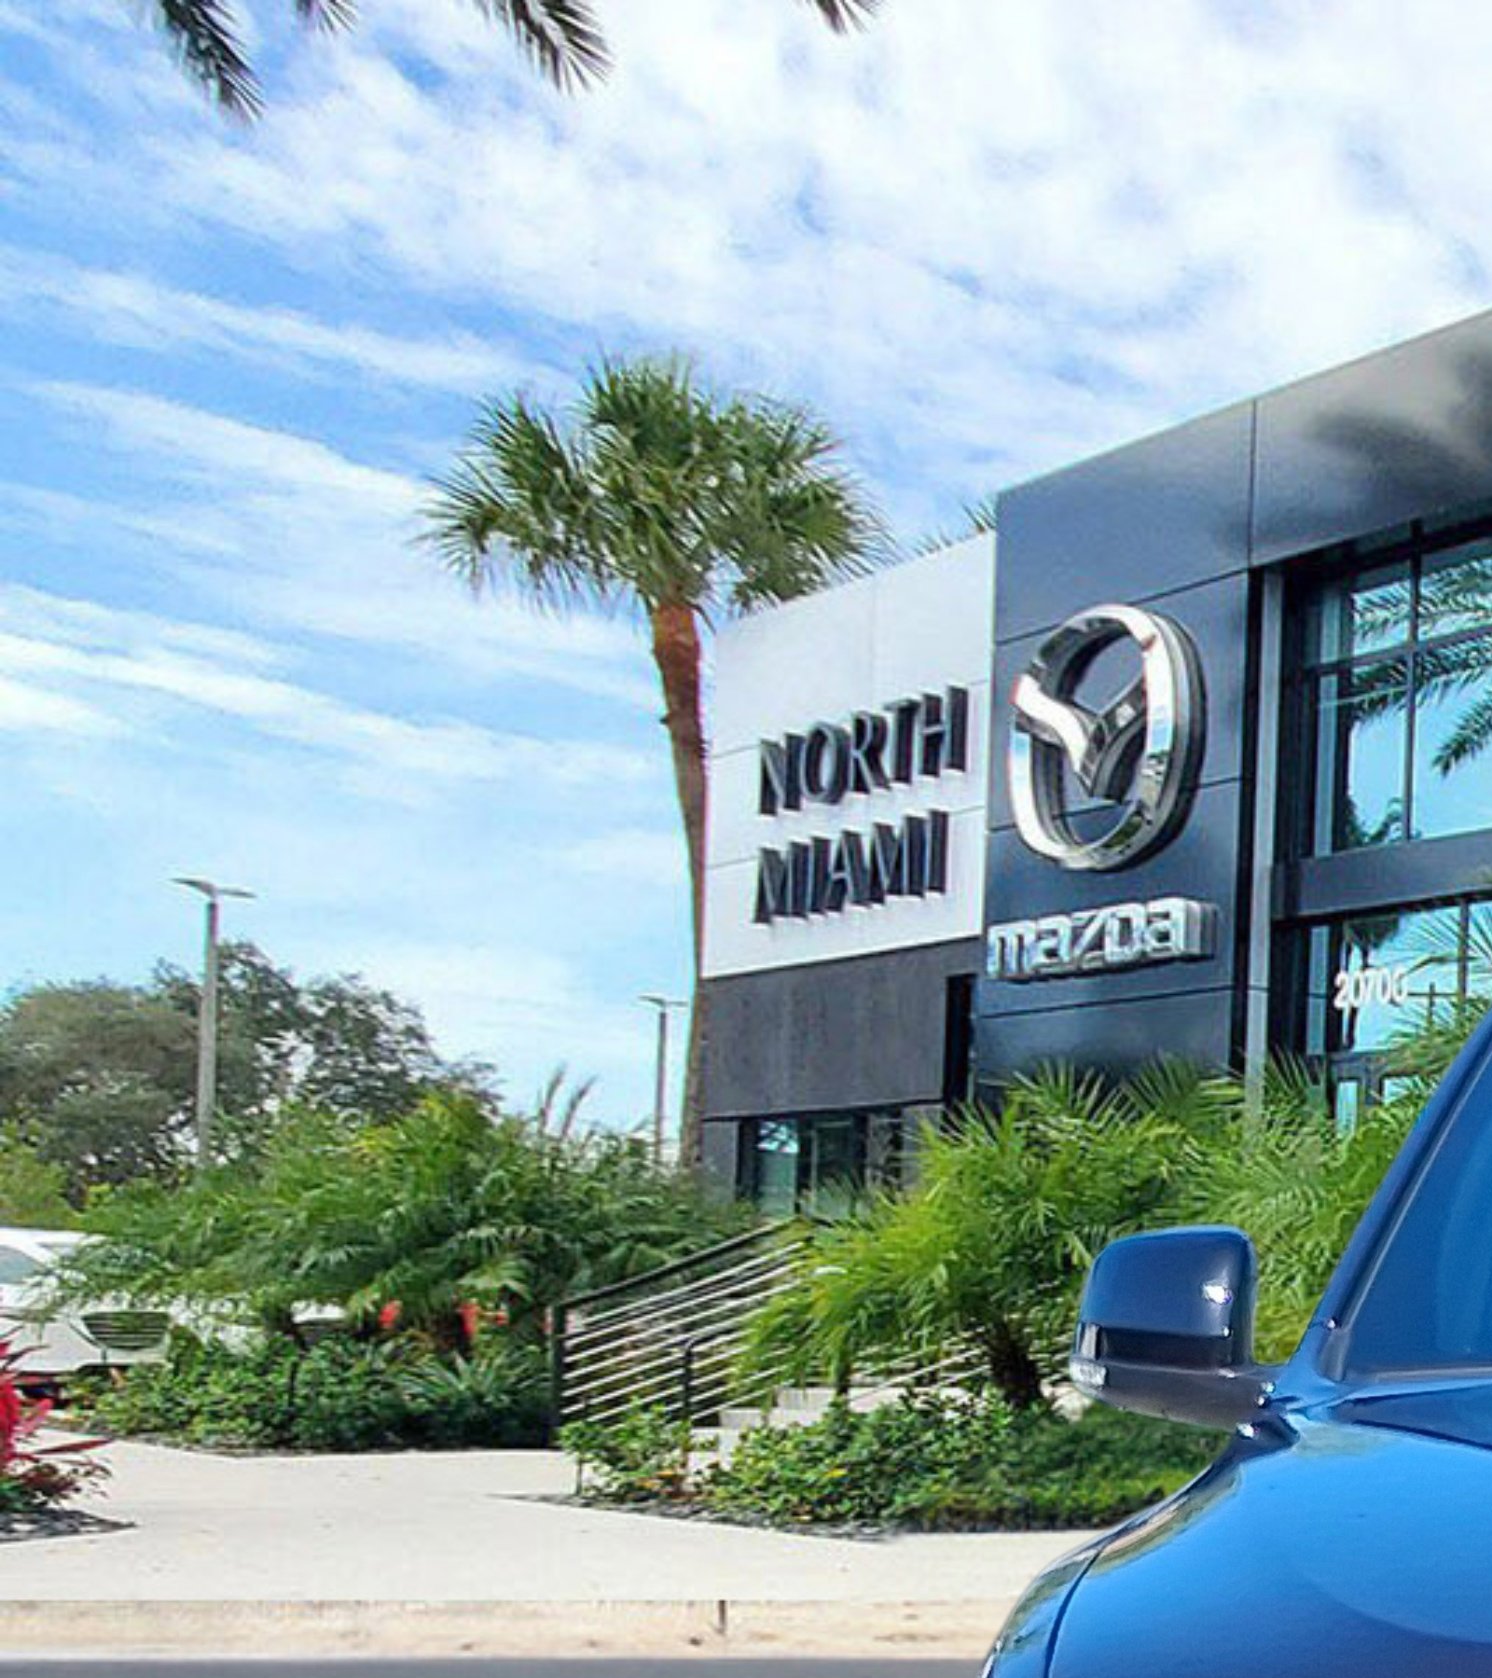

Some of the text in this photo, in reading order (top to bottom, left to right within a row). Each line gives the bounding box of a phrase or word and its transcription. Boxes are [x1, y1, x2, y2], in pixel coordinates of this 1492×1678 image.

[759, 685, 969, 817] NORTH
[753, 808, 950, 924] MIAMI
[986, 897, 1216, 981] mazda
